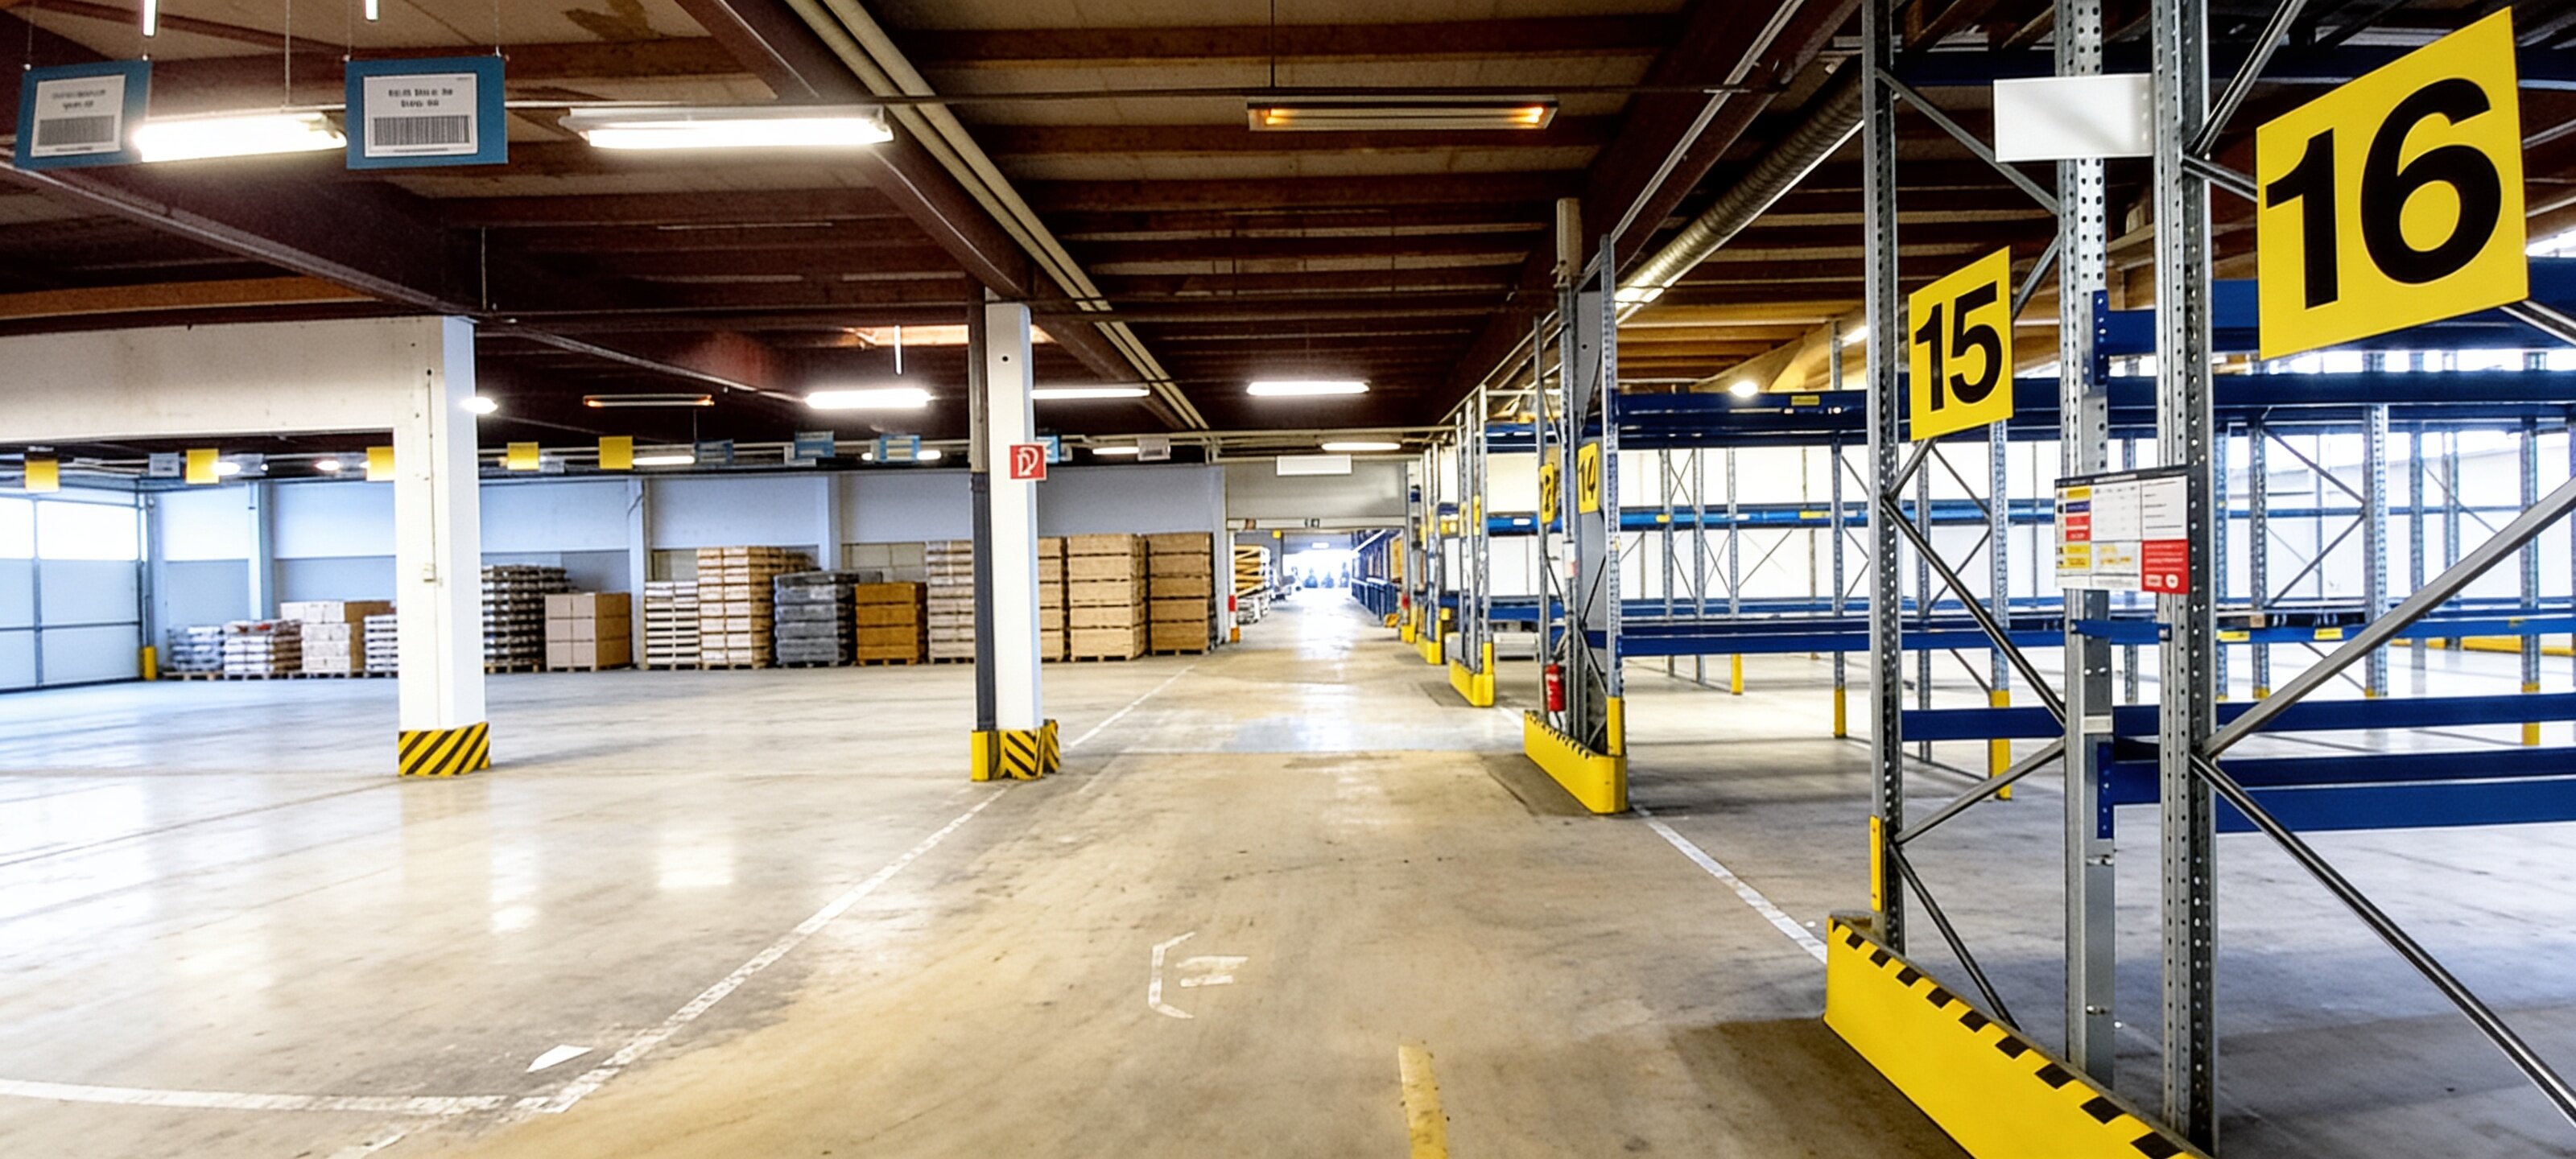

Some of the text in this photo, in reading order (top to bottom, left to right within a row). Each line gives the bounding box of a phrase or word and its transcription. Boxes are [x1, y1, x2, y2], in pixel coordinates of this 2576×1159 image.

[2265, 77, 2502, 311] 16
[1915, 279, 2002, 412] 15
[1579, 456, 1596, 502] 14
